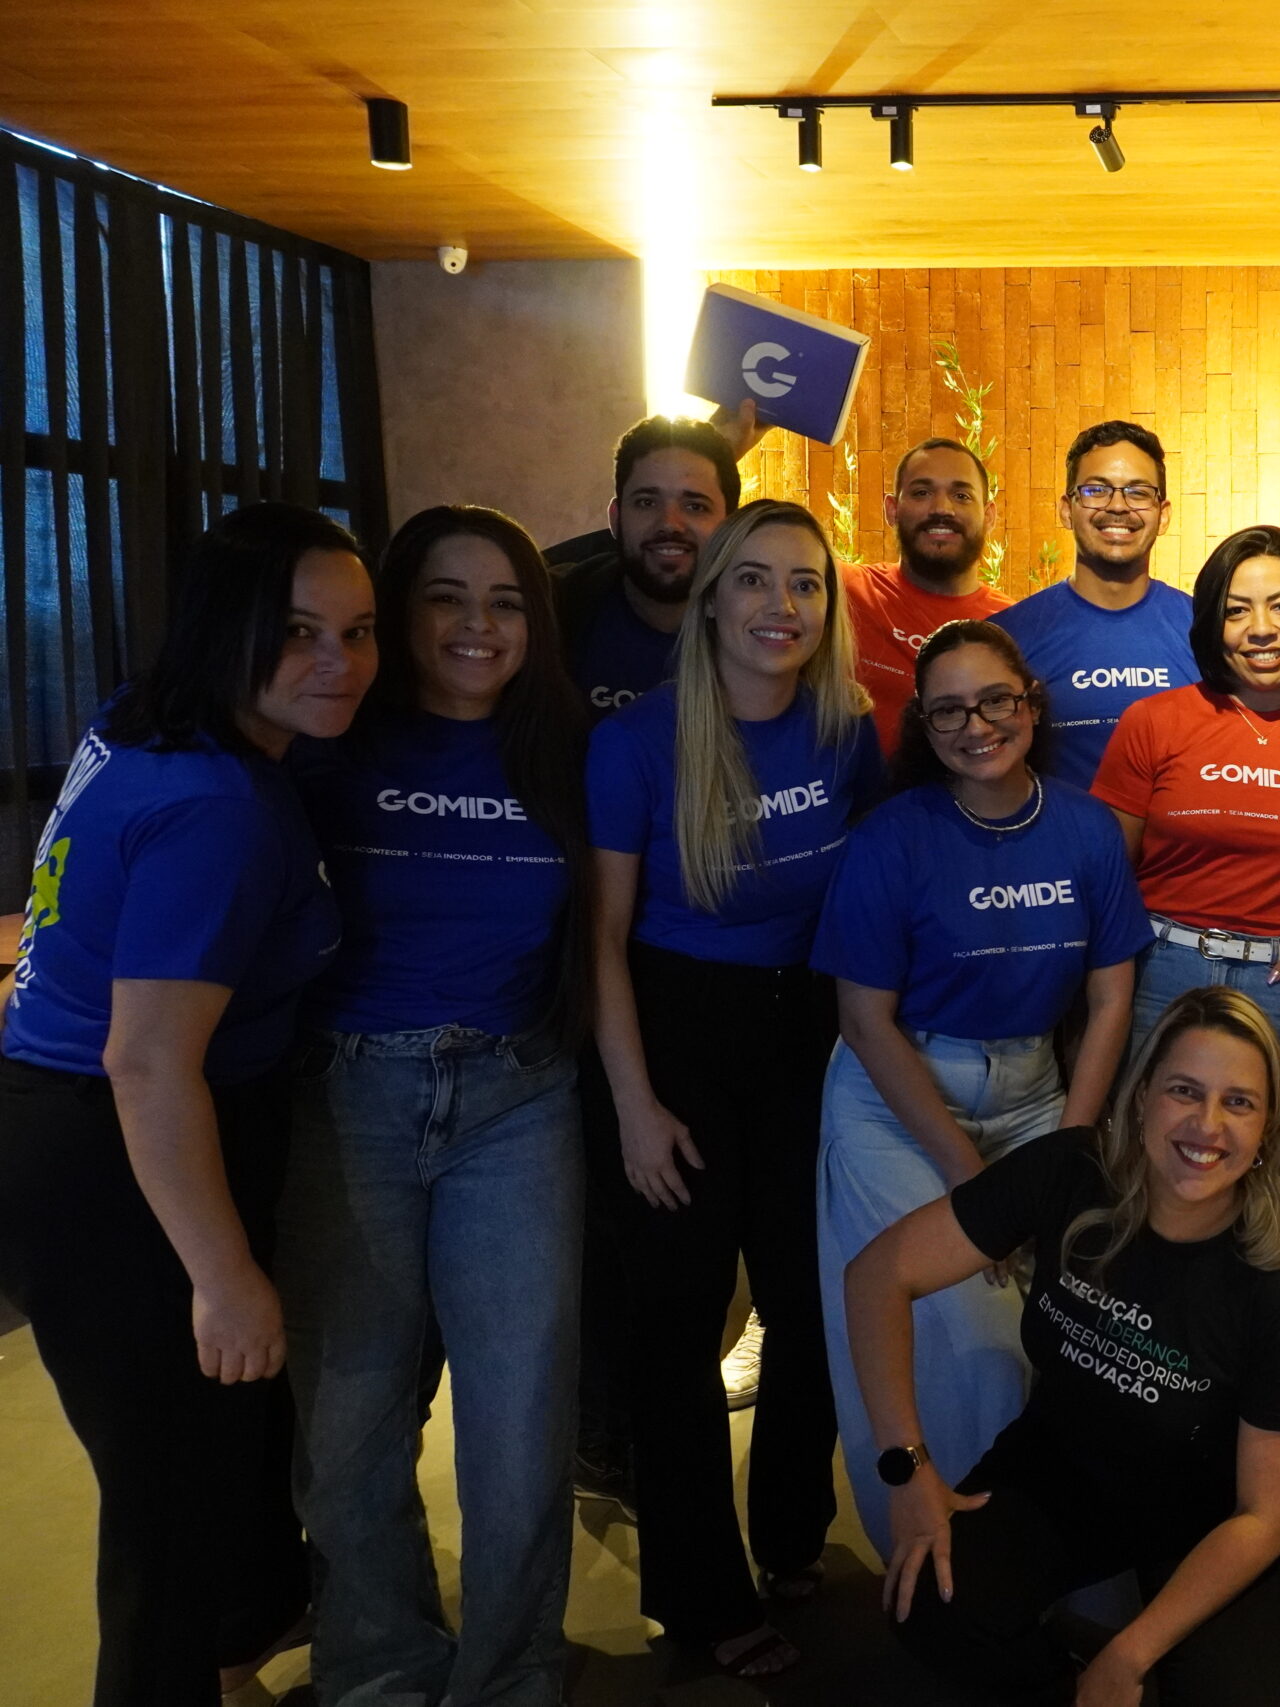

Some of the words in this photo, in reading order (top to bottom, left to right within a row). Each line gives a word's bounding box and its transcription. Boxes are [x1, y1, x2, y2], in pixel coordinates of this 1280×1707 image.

[1071, 667, 1171, 690] GOMIDE
[376, 788, 528, 822] GOMIDE
[1243, 811, 1279, 820] INOVADOR
[443, 852, 493, 862] INOVADOR
[968, 879, 1075, 910] GOMIDE
[1058, 1271, 1153, 1331] EXECUÇÃO
[1038, 1291, 1212, 1394] EMPREENDEDORISMO
[1095, 1312, 1191, 1372] LIDERANÇA
[1059, 1340, 1160, 1404] INOVAÇÃO
